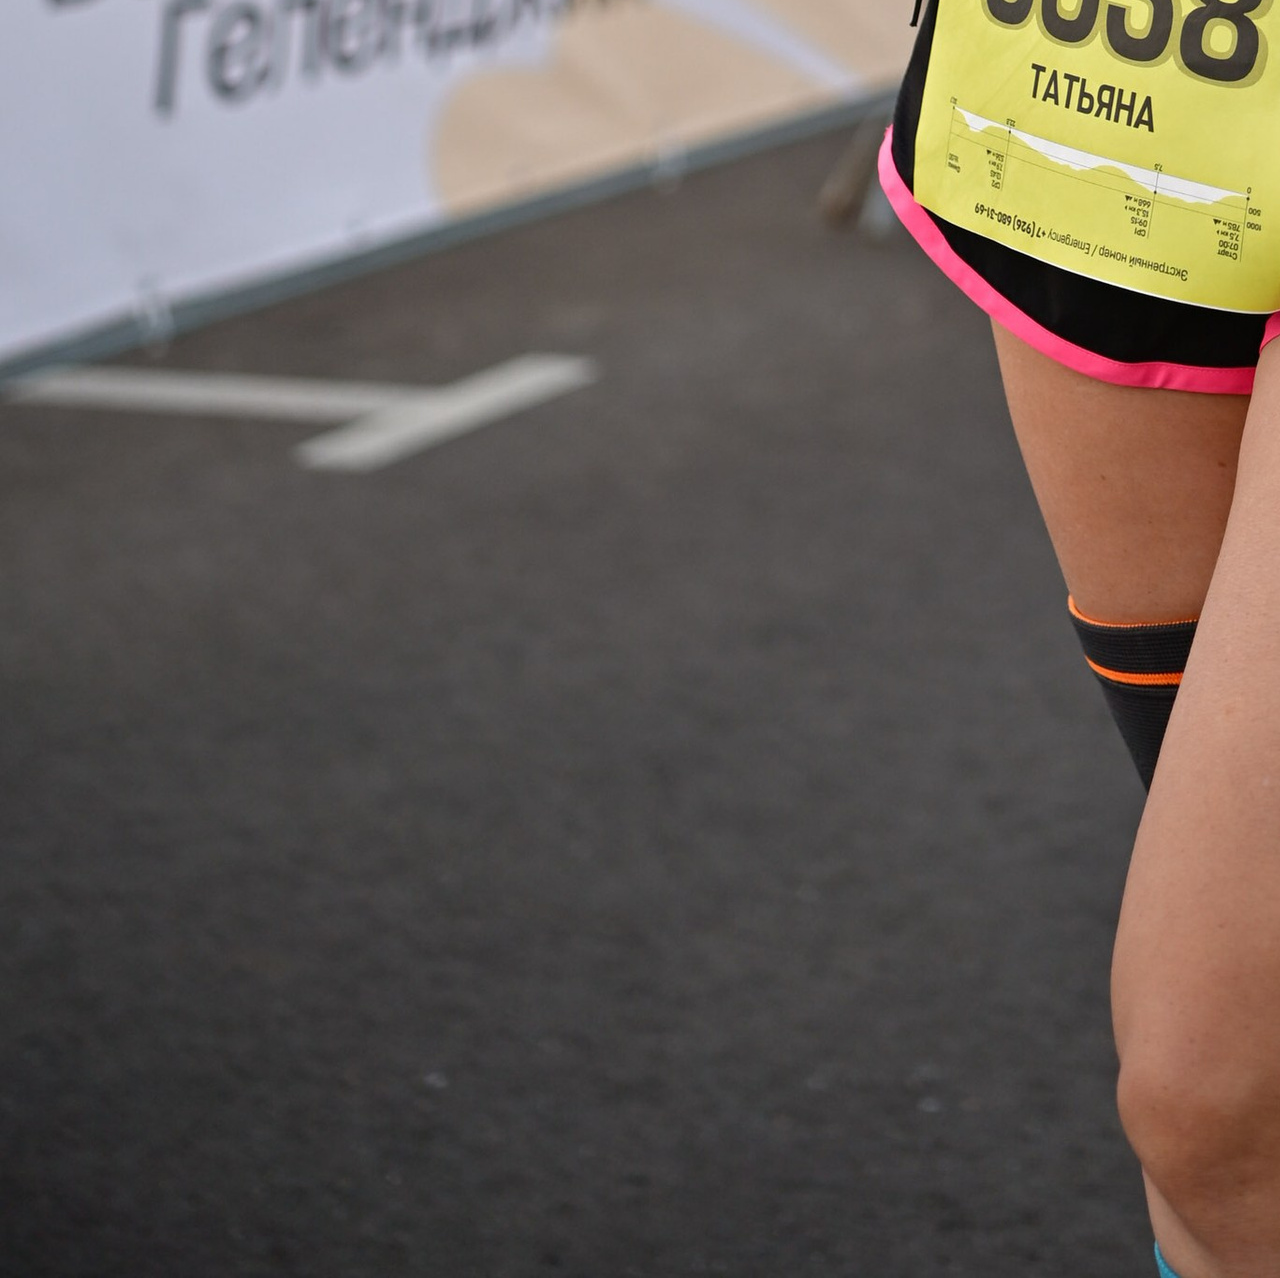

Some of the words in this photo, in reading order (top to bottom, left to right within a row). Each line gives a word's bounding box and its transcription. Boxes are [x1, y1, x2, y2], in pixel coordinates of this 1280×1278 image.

[1030, 63, 1155, 133] ТАТЬЯНА
[974, 202, 1012, 226] 680-31-69
[1248, 207, 1261, 217] 500
[1012, 214, 1036, 238] (926)
[1228, 222, 1241, 232] 785
[1246, 221, 1262, 231] 1000
[1035, 227, 1046, 238] +7
[1134, 228, 1146, 237] CP1
[1047, 228, 1091, 255] Emergency
[1218, 240, 1239, 251] 07:00
[1098, 244, 1127, 263] номер
[1217, 249, 1238, 261] Старт
[1129, 254, 1189, 282] Экстренный
